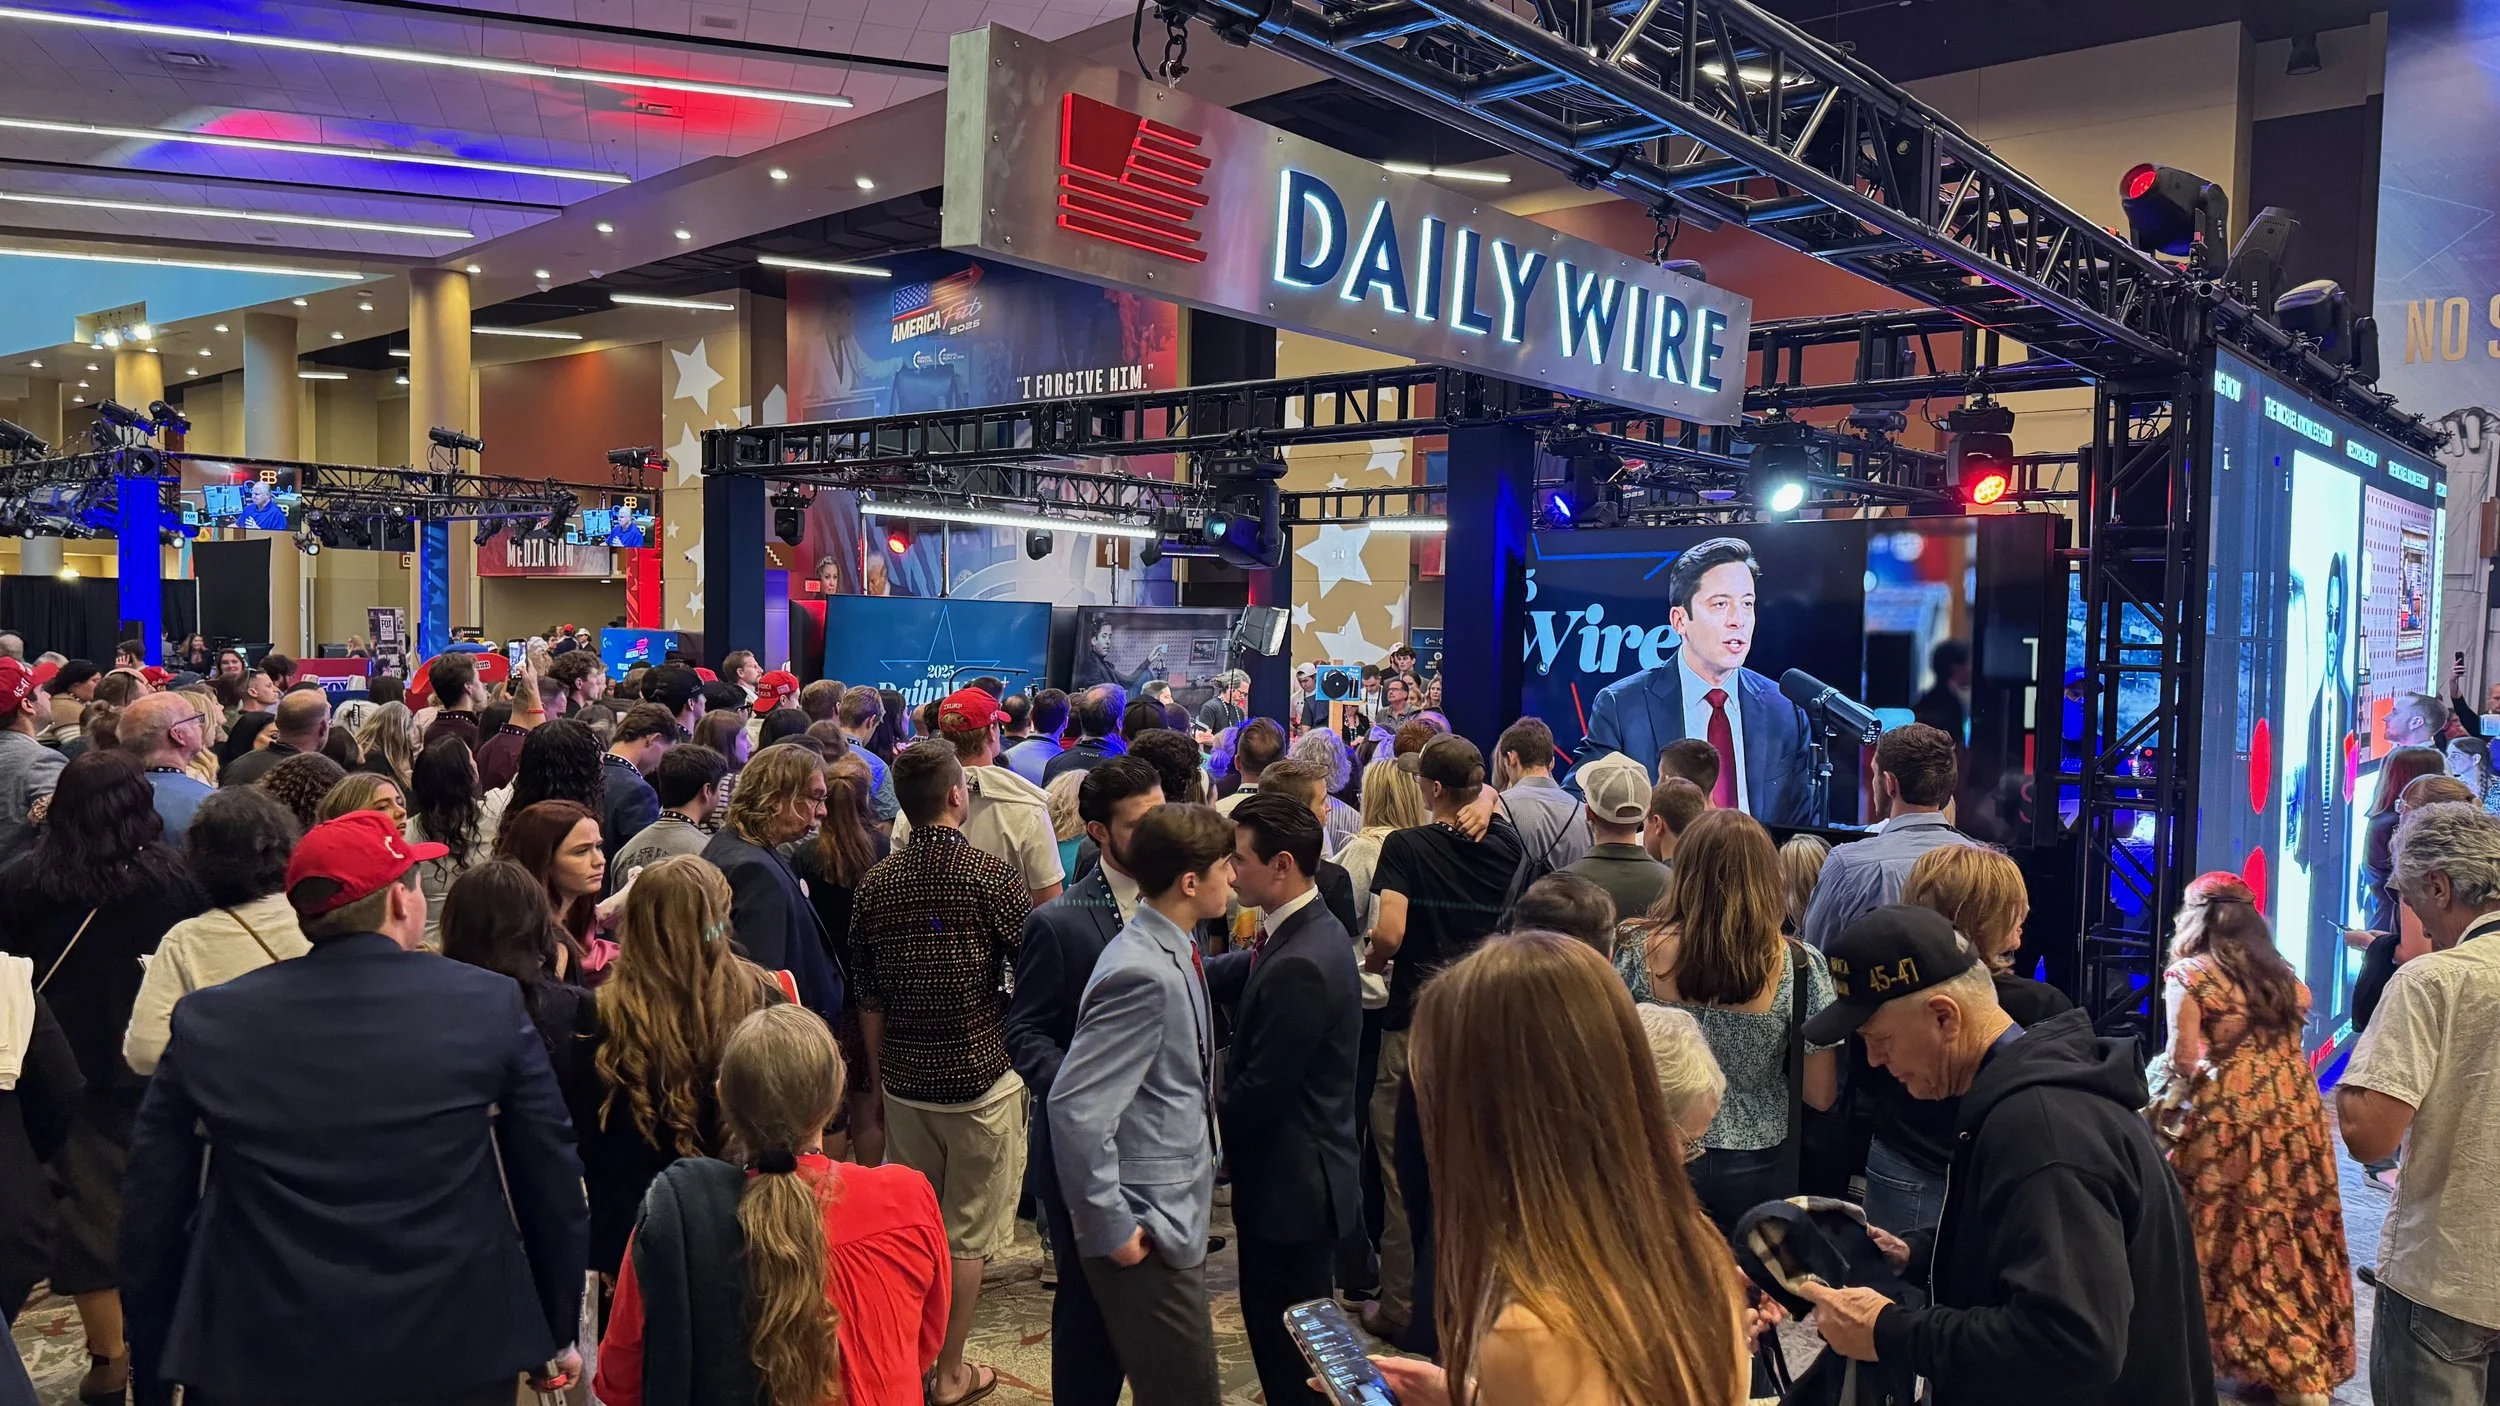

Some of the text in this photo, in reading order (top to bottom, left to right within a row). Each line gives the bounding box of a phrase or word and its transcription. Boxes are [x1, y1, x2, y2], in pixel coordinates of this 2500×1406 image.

[891, 311, 941, 344] AMERICA
[949, 319, 981, 336] 2025
[2404, 296, 2470, 365] NO
[1036, 369, 1104, 398] FORGIVE
[1623, 490, 1645, 499] 025
[507, 538, 574, 567] MEDIA ROW
[927, 664, 956, 679] 2025
[13, 676, 31, 698] 45-47
[1869, 957, 1920, 992] 45-47
